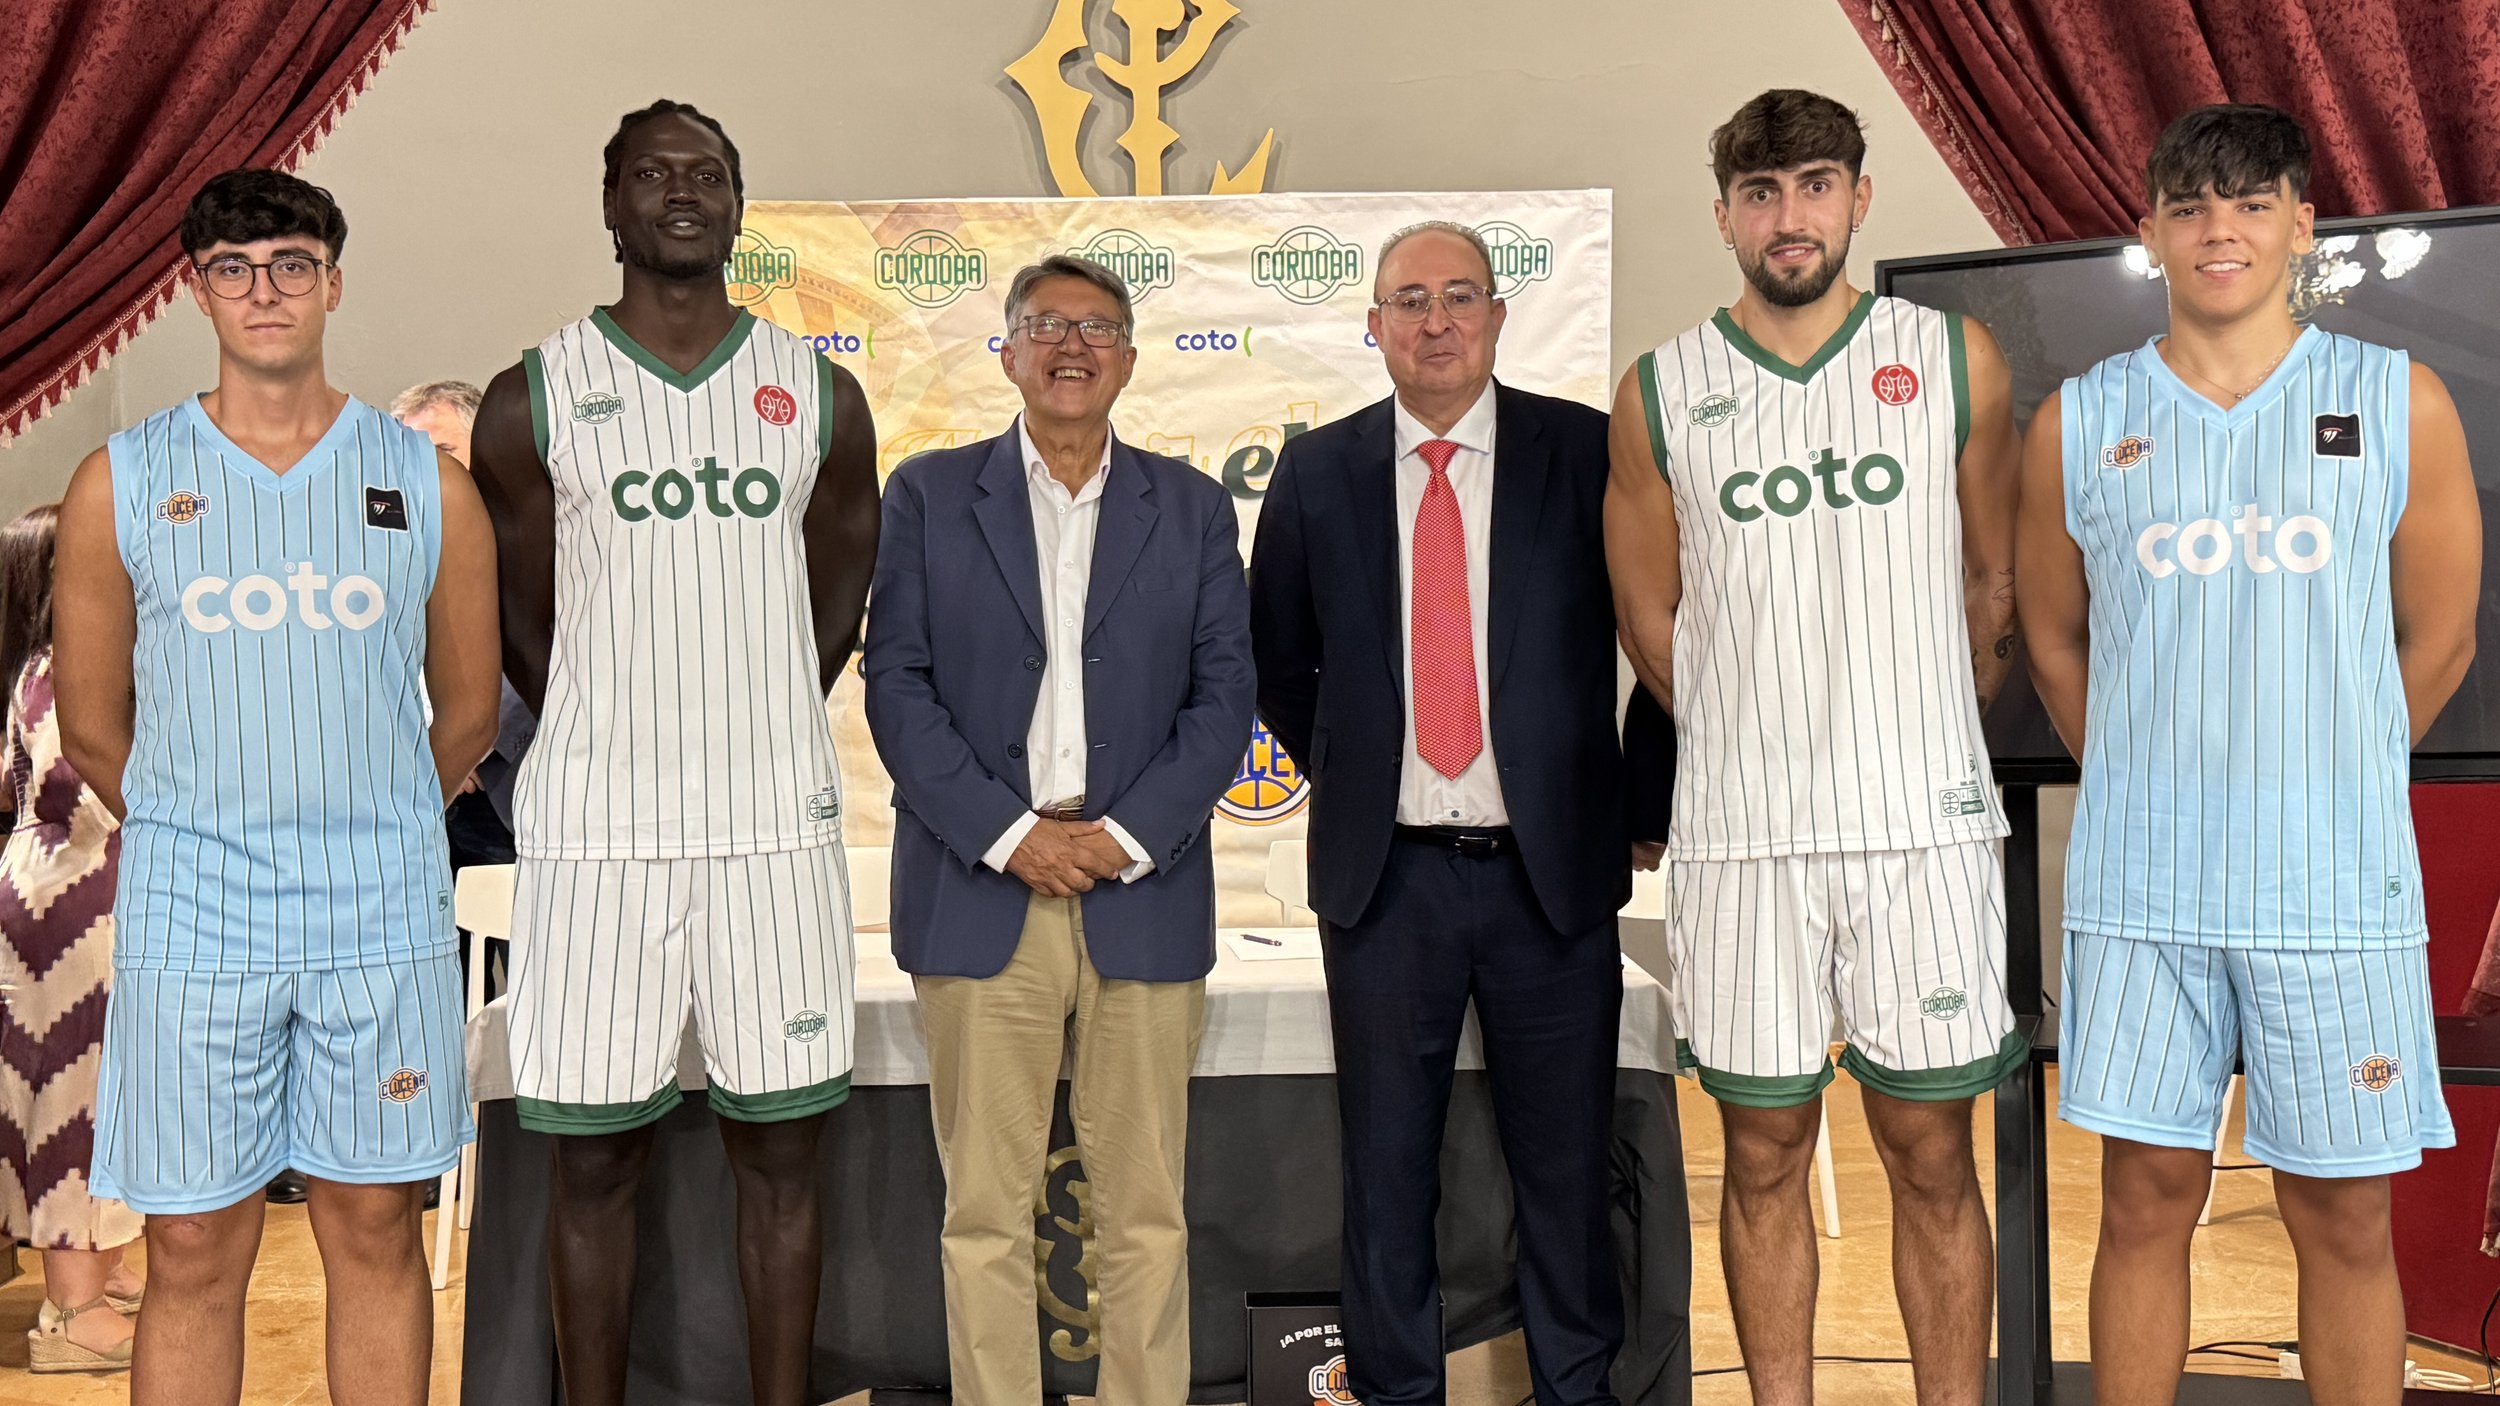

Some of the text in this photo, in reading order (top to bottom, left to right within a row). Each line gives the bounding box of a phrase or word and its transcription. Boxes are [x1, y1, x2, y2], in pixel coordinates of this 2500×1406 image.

[1491, 245, 1547, 275] DOBA
[1175, 329, 1238, 351] coto
[611, 456, 781, 522] coto
[1720, 447, 1904, 523] coto
[2136, 503, 2332, 579] coto
[181, 561, 385, 633] coto
[1295, 1326, 1323, 1341] POR
[1324, 1324, 1342, 1334] EL
[1325, 1337, 1345, 1348] SA
